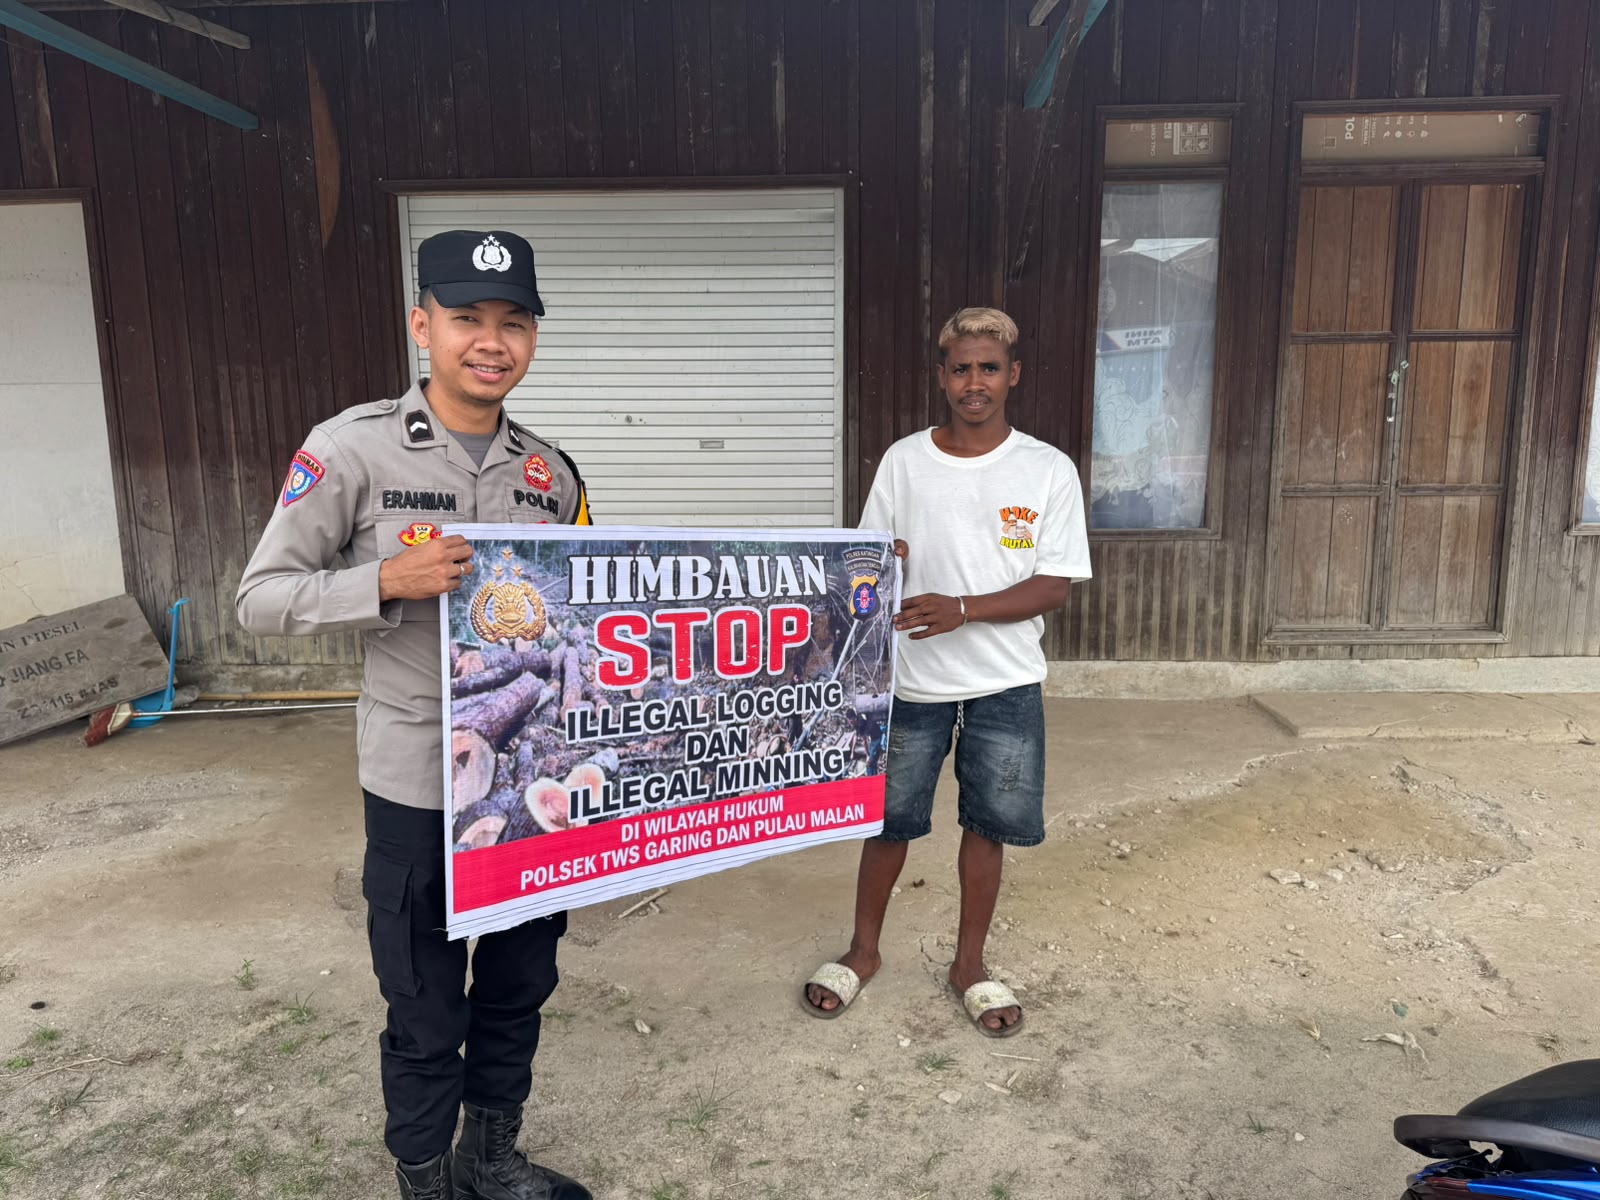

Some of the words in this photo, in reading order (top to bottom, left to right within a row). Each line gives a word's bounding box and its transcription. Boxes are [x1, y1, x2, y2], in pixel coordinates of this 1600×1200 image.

[513, 489, 559, 517] POLRI
[999, 536, 1034, 549] BRUTAL
[568, 554, 827, 605] HIMBAUAN
[11, 656, 63, 683] JIANG
[64, 648, 90, 666] FA
[595, 604, 812, 690] STOP
[566, 698, 710, 743] ILLEGAL
[717, 682, 843, 723] LOGGING
[686, 728, 749, 763] DAN
[568, 771, 711, 822] ILLEGAL
[717, 749, 845, 794] MINNING
[621, 824, 640, 843] DI
[642, 807, 720, 839] WILAYAH
[723, 794, 784, 819] HUKUM
[520, 855, 597, 890] POLSEK
[600, 845, 641, 868] TWS
[644, 830, 712, 860] GARING
[716, 823, 751, 846] DAN
[754, 812, 806, 839] PULAU
[810, 803, 865, 827] MALAN
